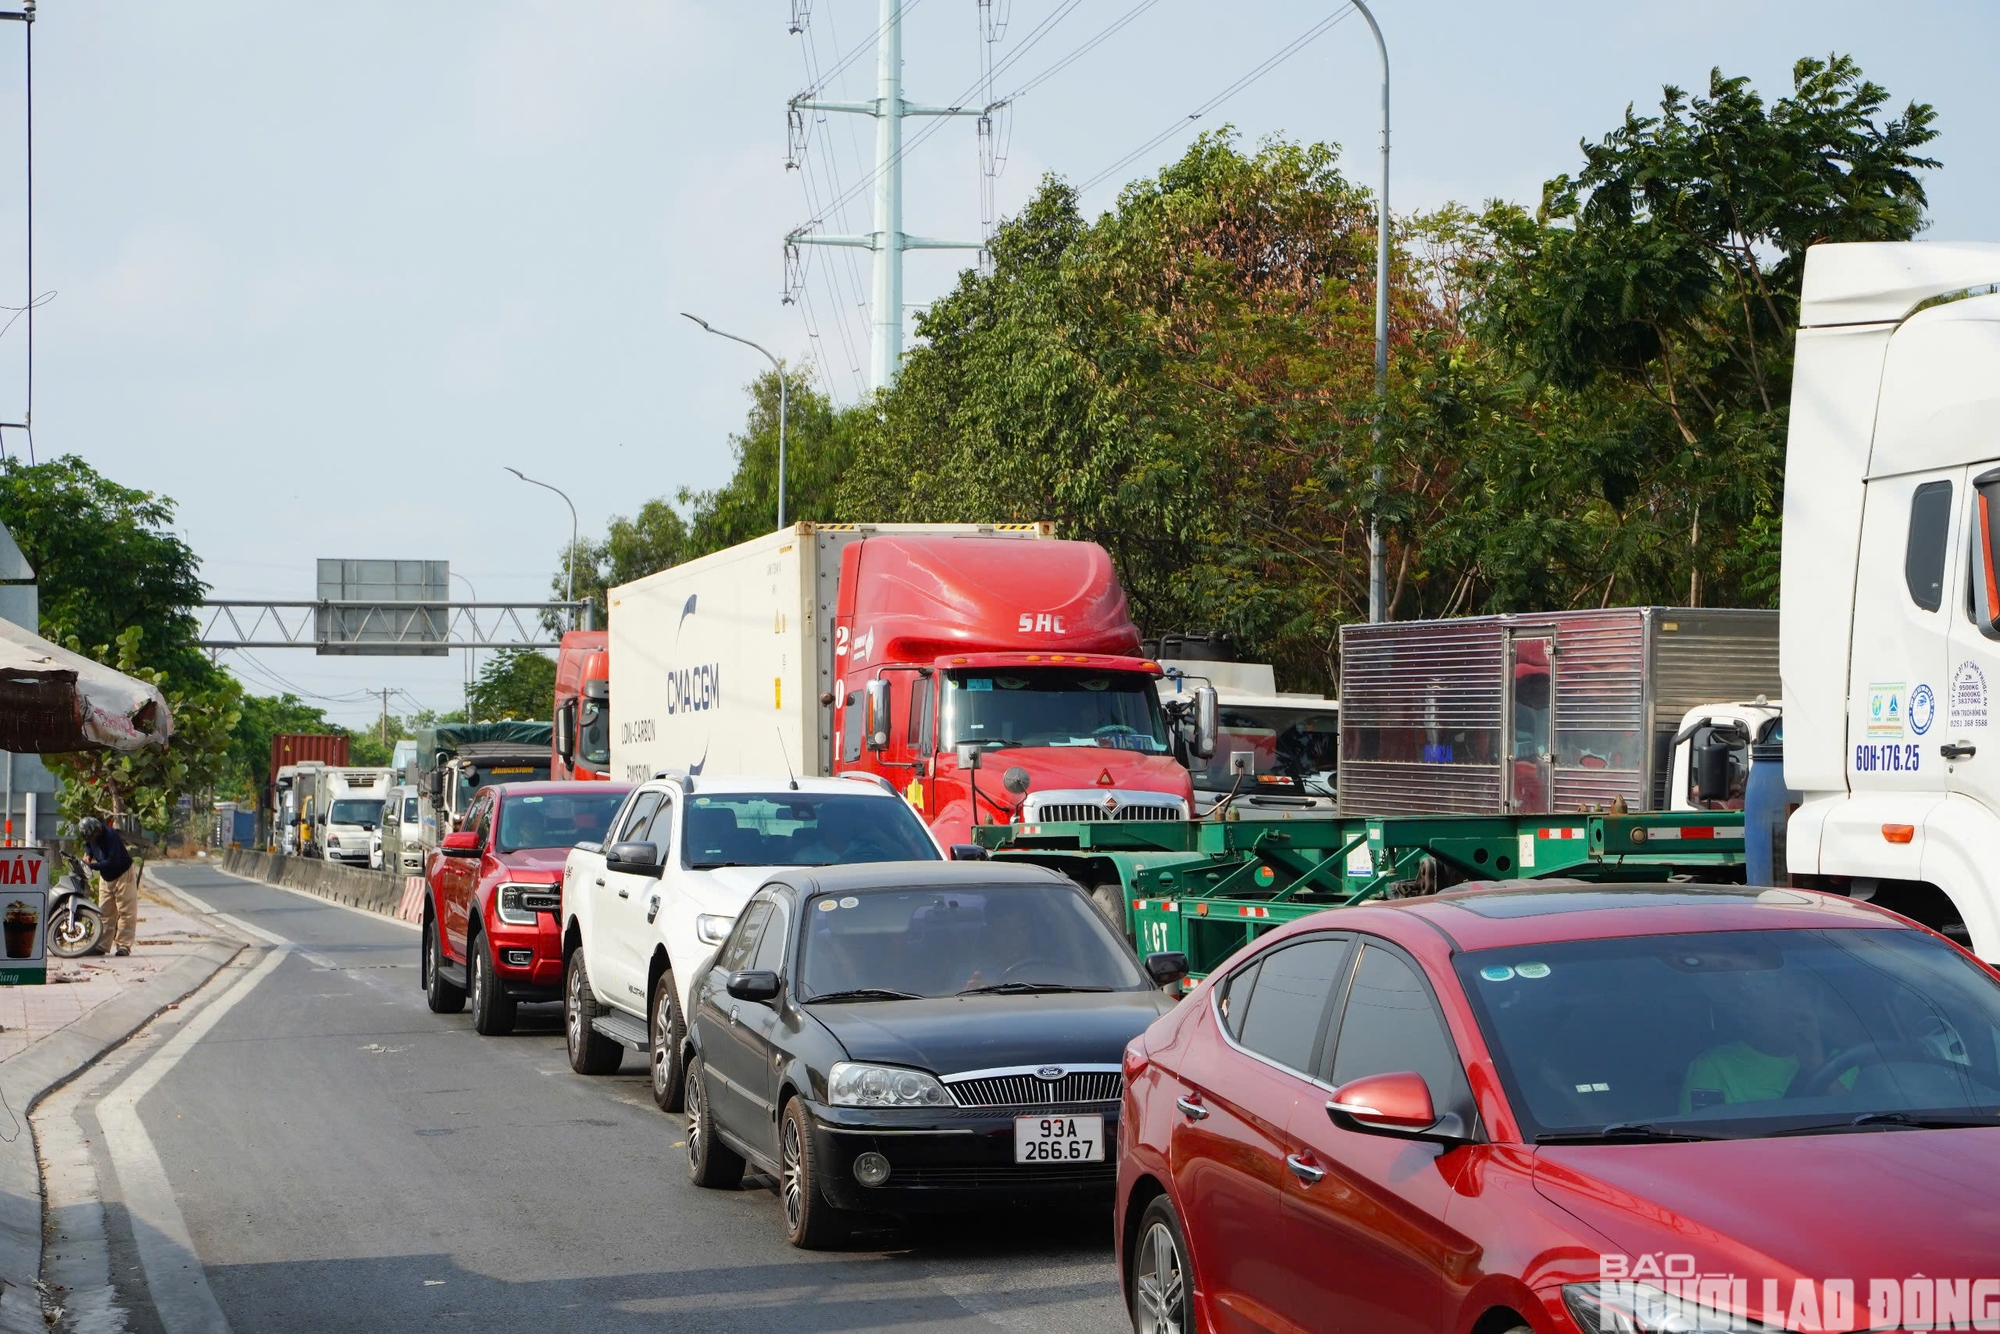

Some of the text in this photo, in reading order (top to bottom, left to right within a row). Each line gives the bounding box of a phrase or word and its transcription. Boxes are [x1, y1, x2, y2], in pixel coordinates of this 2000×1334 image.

[667, 669, 691, 714] CMA
[693, 663, 720, 711] CGM
[621, 719, 656, 744] LOW-CARBON
[1856, 744, 1920, 771] 60H-176.25
[1040, 1119, 1077, 1138] 93A
[1025, 1140, 1093, 1160] 266.67
